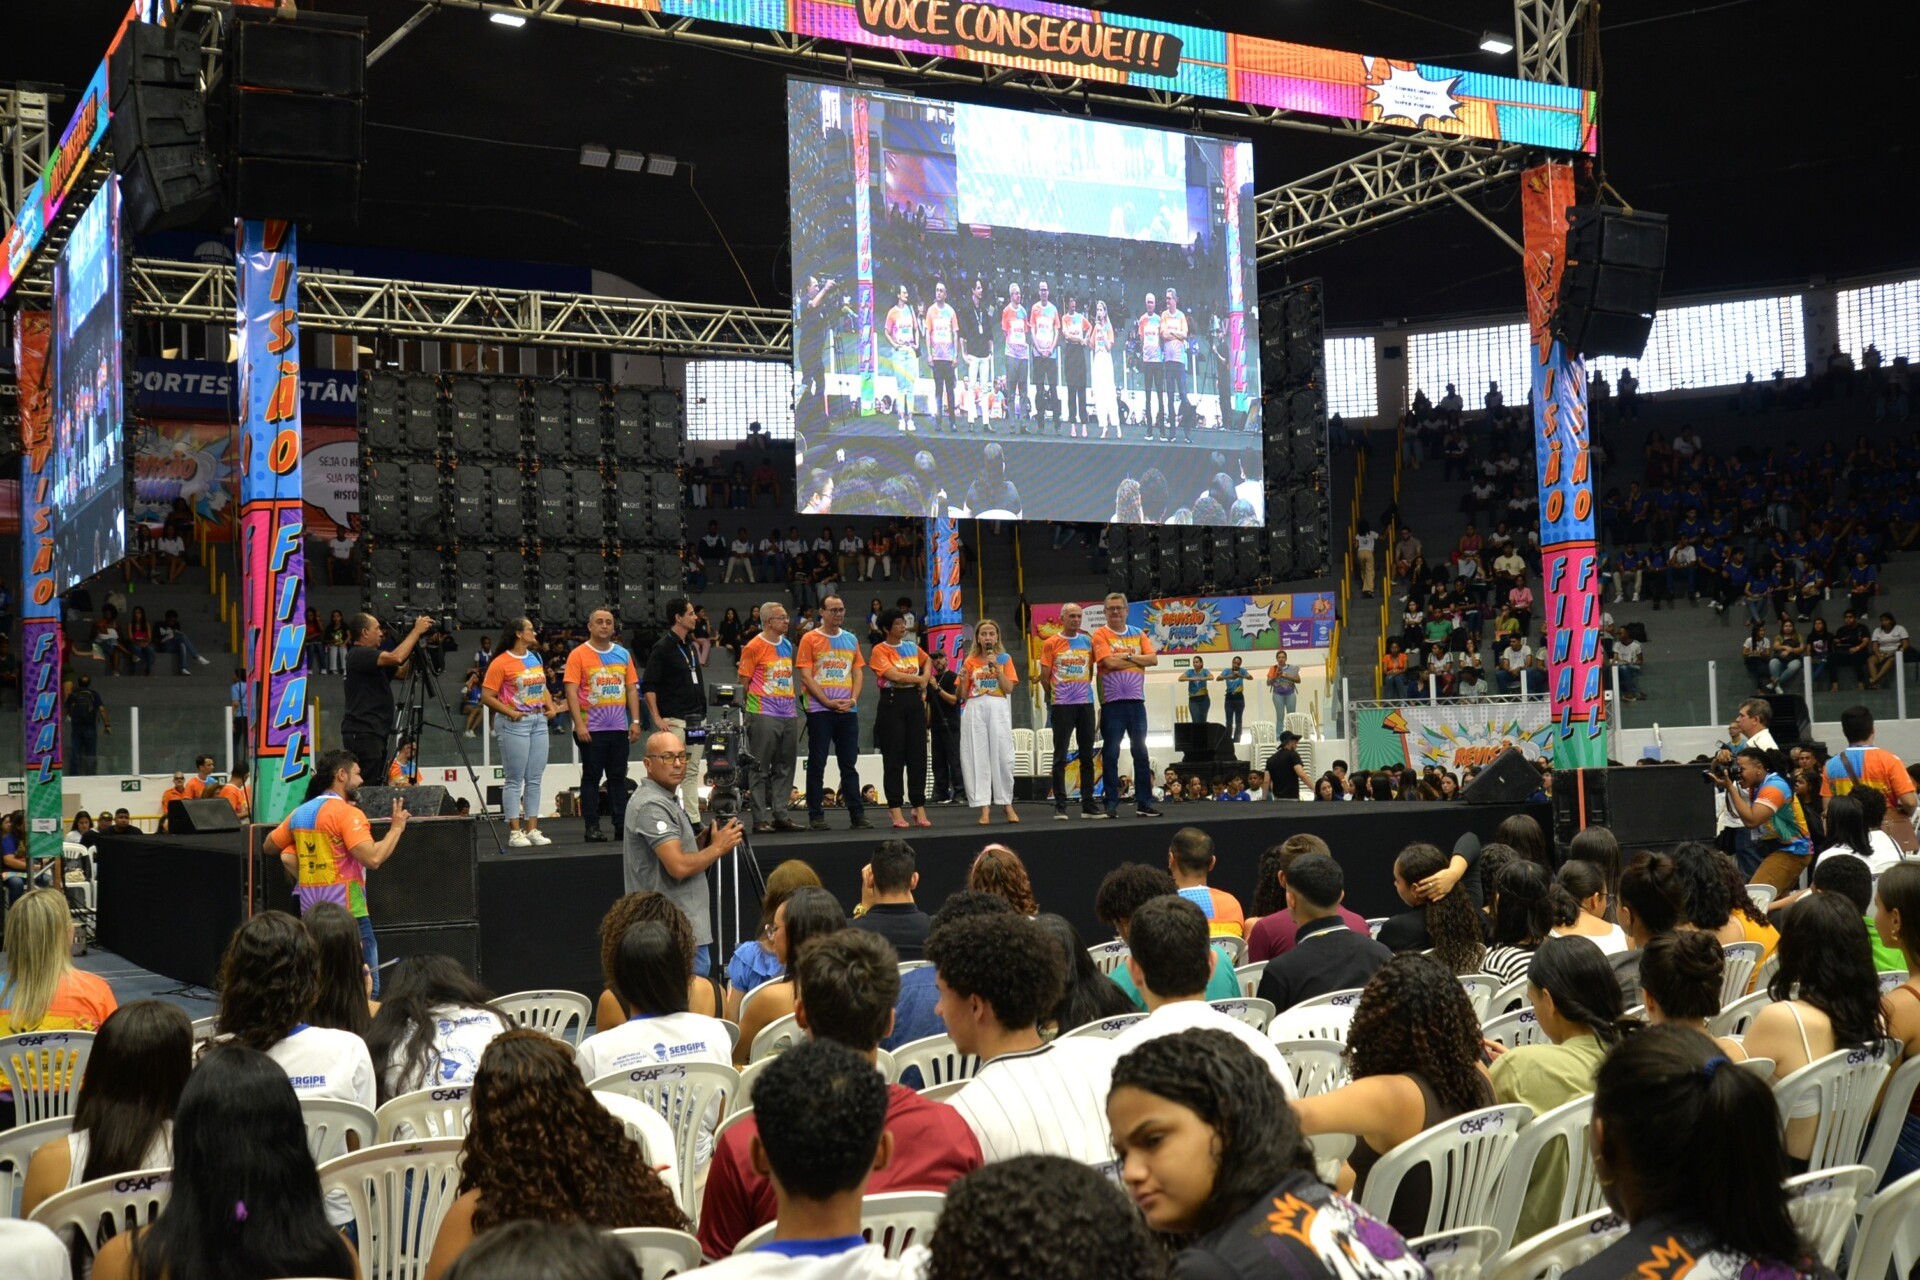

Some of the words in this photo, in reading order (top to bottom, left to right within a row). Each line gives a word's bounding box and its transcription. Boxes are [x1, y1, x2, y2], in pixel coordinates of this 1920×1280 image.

[955, 4, 1165, 68] CONSEGUE!!!
[318, 456, 341, 467] SEJA
[342, 457, 348, 466] O
[326, 473, 344, 484] SUA
[1162, 609, 1206, 626] REVISÃO
[1168, 625, 1198, 641] FINAL
[270, 522, 306, 780] FINAL
[1550, 555, 1571, 739] FINAL
[1577, 555, 1599, 739] FINAL
[32, 632, 56, 785] FINAL
[669, 1041, 706, 1054] SERGIPE
[288, 1075, 326, 1085] ERGIPE
[431, 1088, 466, 1101] OSAF
[114, 1175, 161, 1194] OSAF
